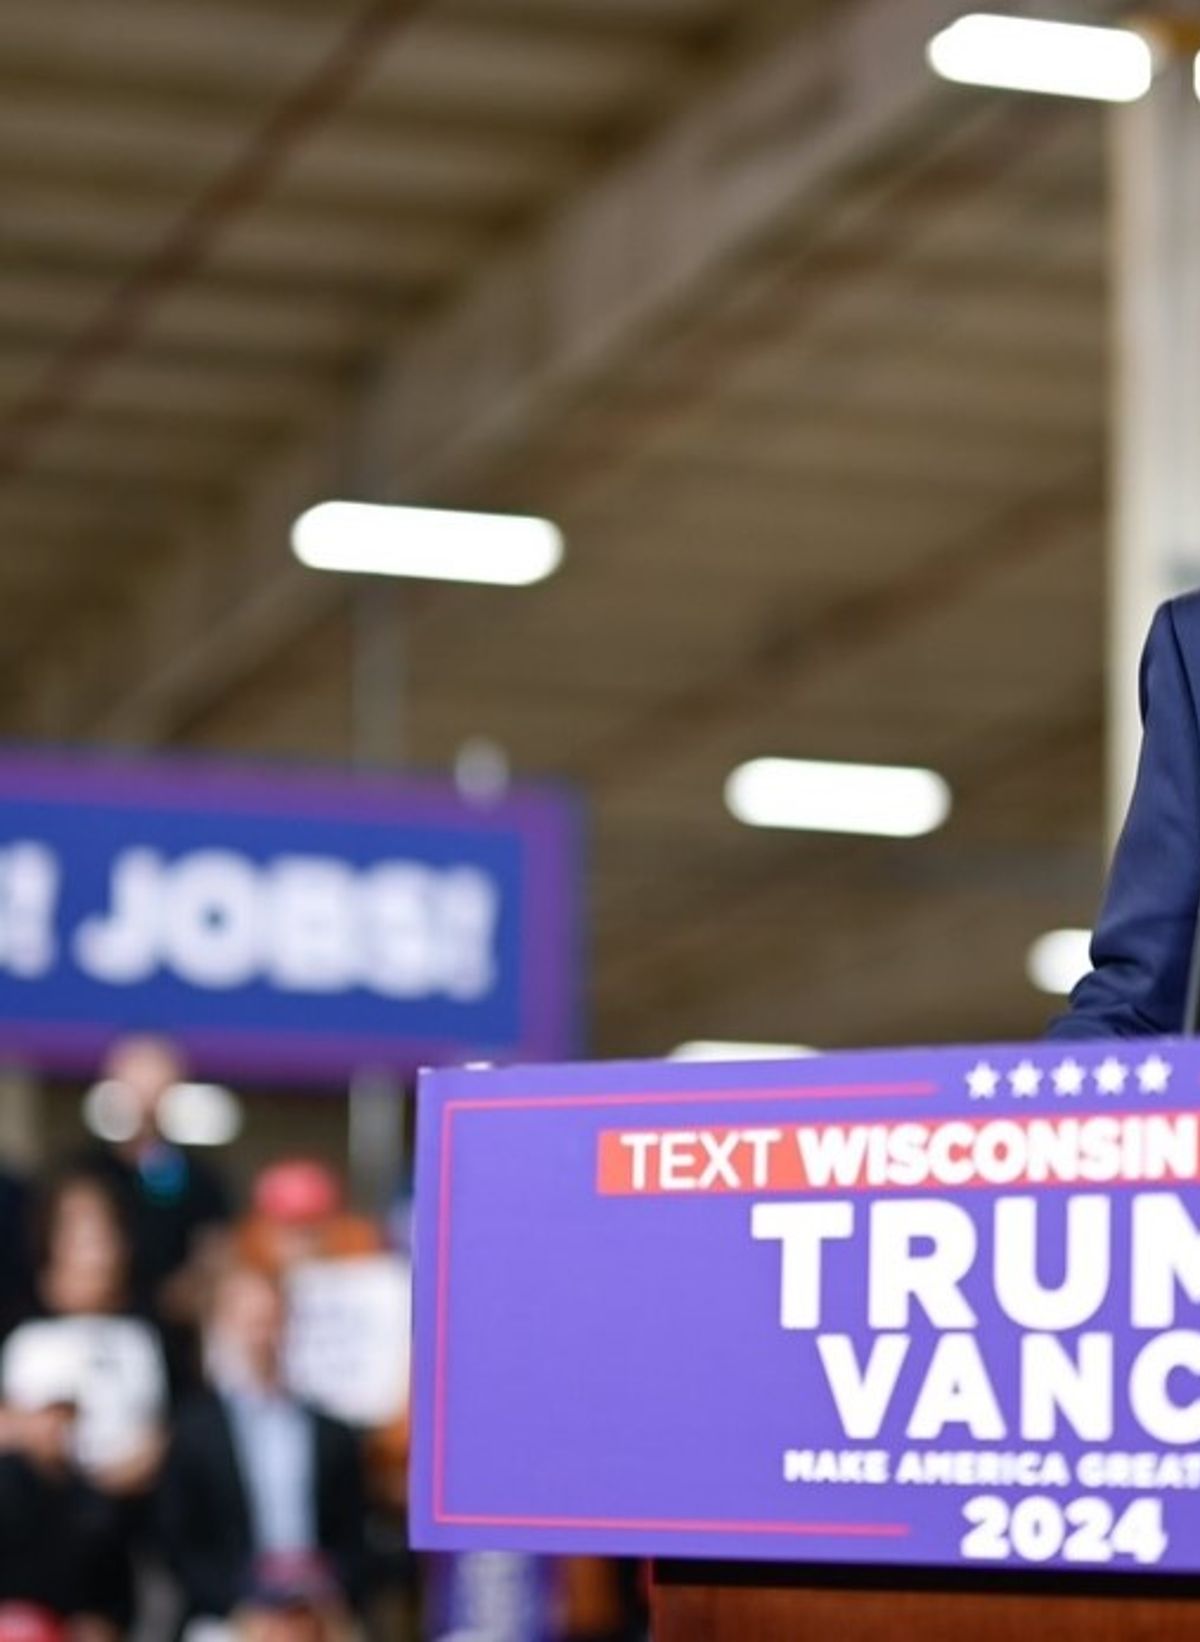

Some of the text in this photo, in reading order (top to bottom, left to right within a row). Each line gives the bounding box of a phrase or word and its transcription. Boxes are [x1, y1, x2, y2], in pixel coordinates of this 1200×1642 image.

[75, 847, 494, 998] JOBS!
[621, 1130, 780, 1189] TEXT
[798, 1114, 1198, 1187] WISCONSIN
[783, 1450, 889, 1484] MAKE
[896, 1451, 1071, 1488] AMERICA
[960, 1496, 1167, 1563] 2024
